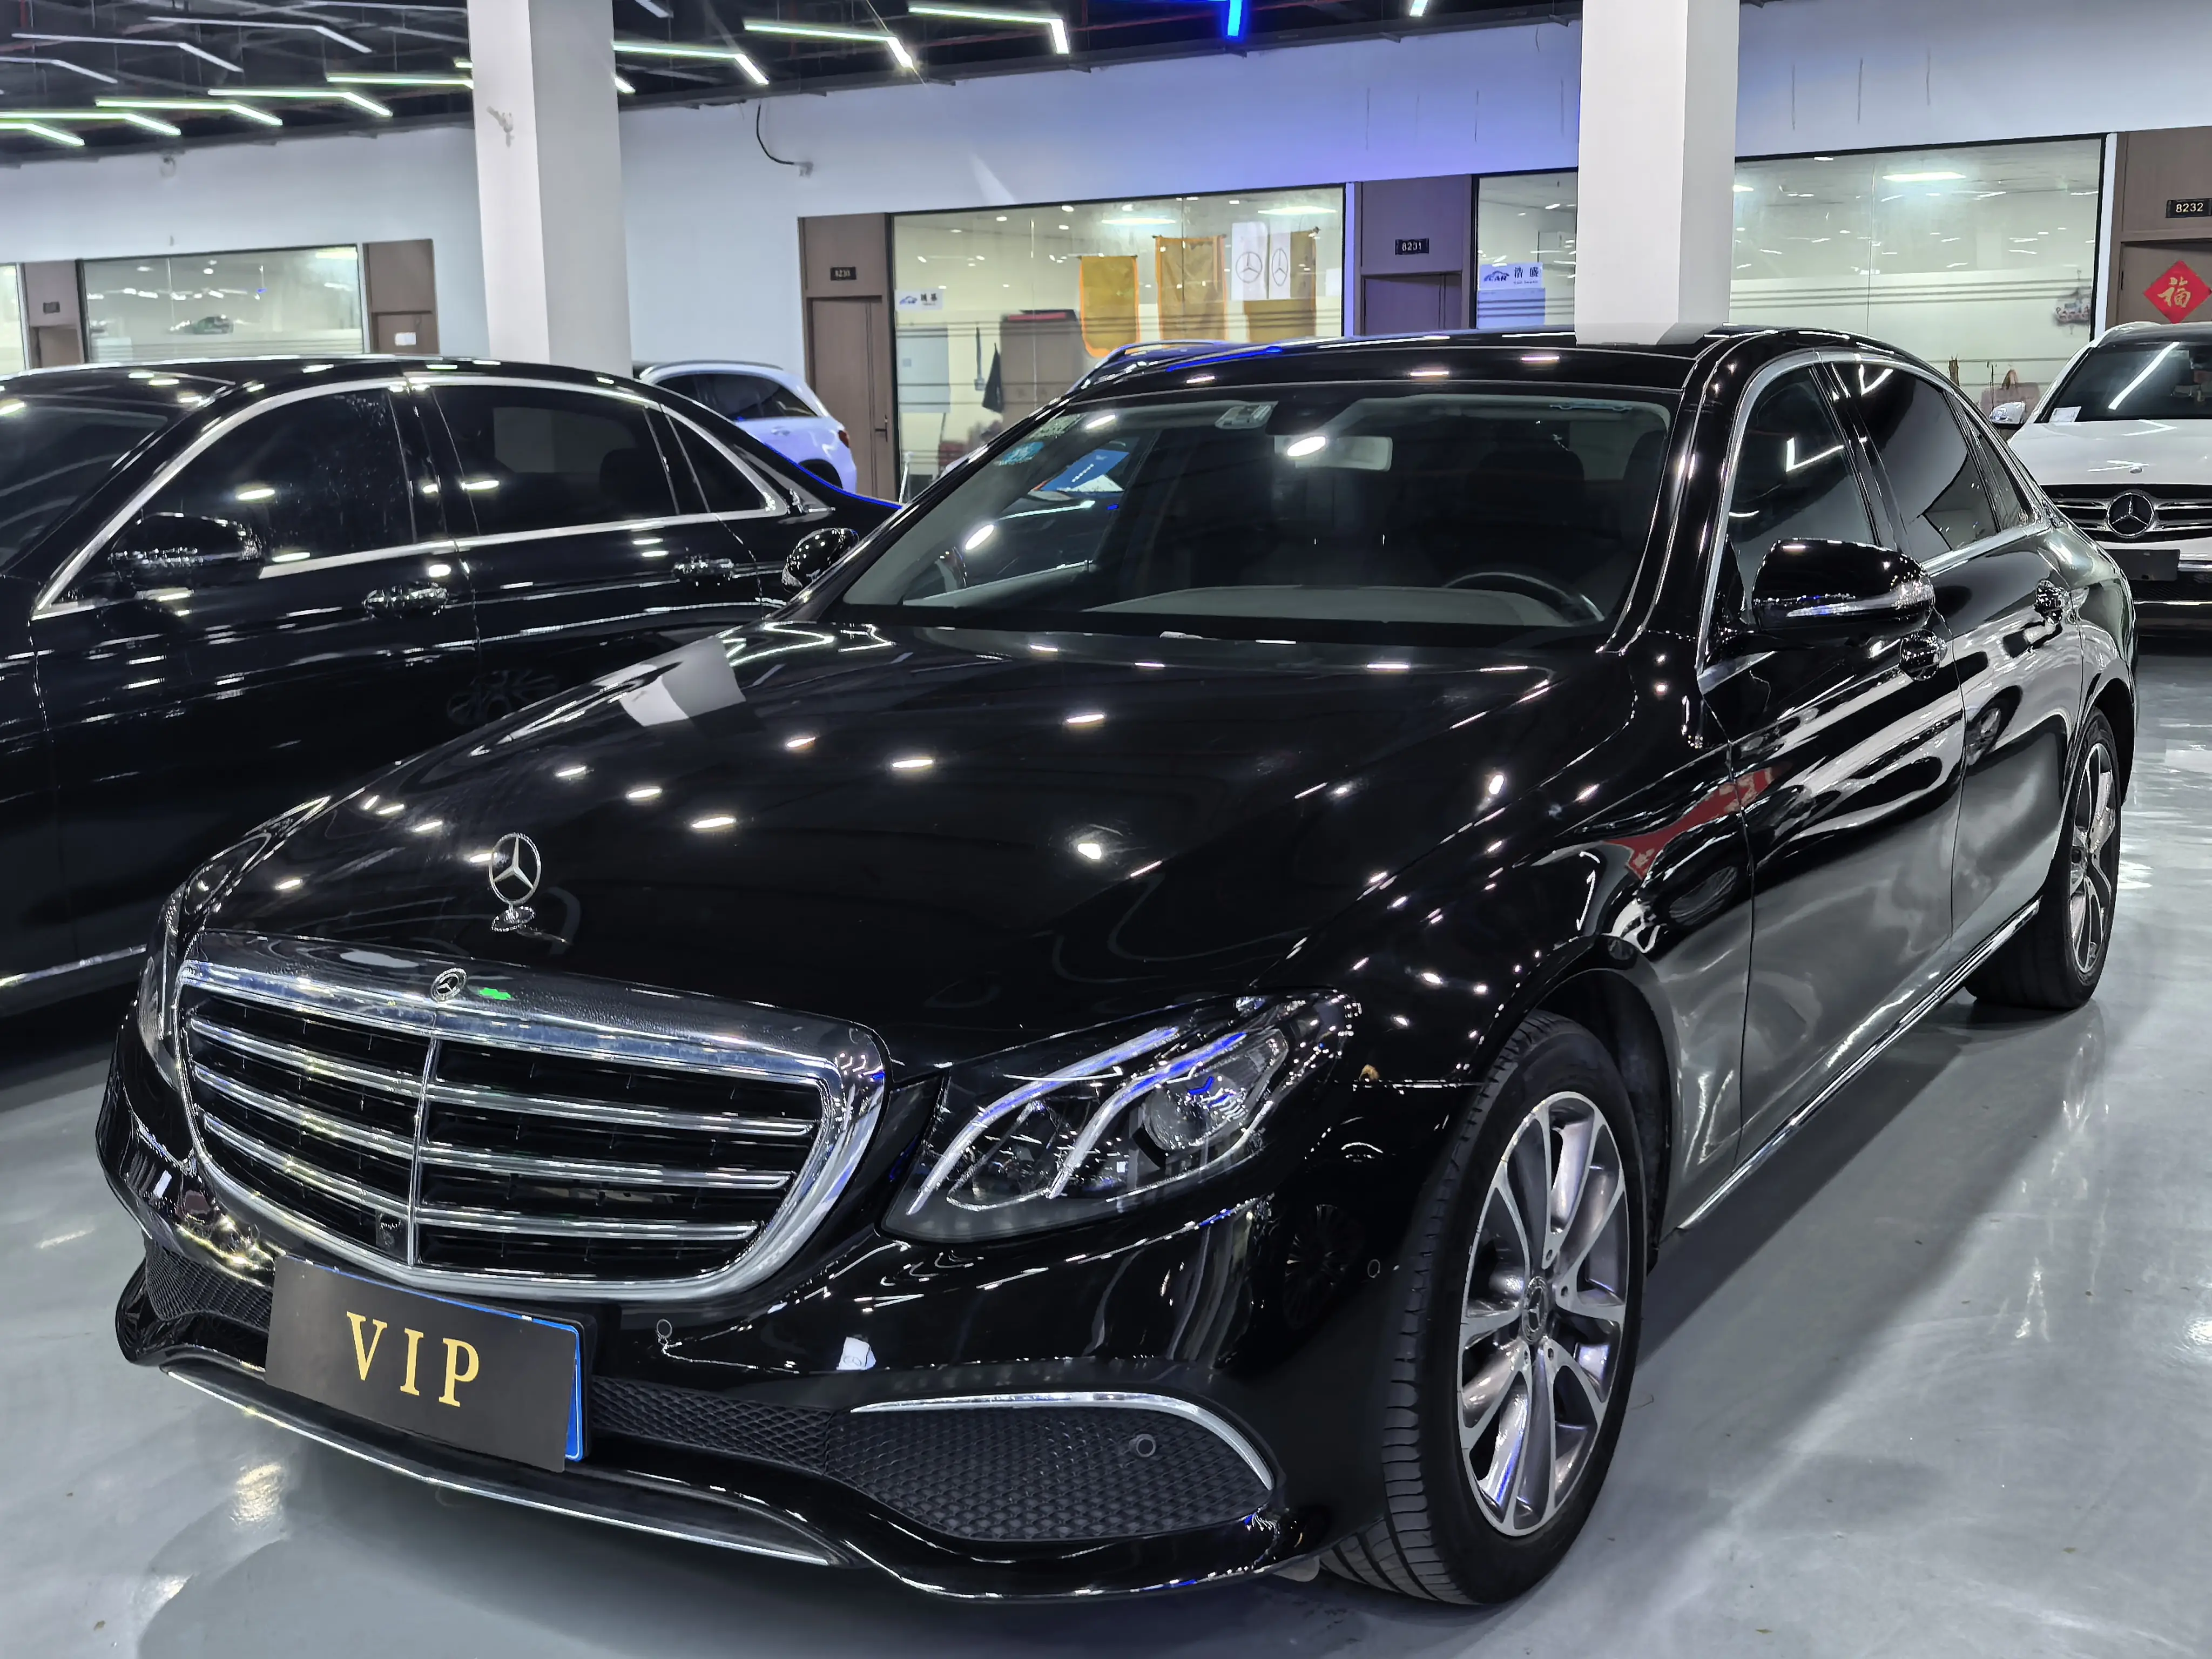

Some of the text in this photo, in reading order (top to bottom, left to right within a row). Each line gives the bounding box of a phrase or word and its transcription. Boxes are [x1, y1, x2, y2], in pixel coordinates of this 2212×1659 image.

[2176, 203, 2204, 213] 8232
[2157, 276, 2191, 308] 福
[346, 1311, 480, 1407] VIP
